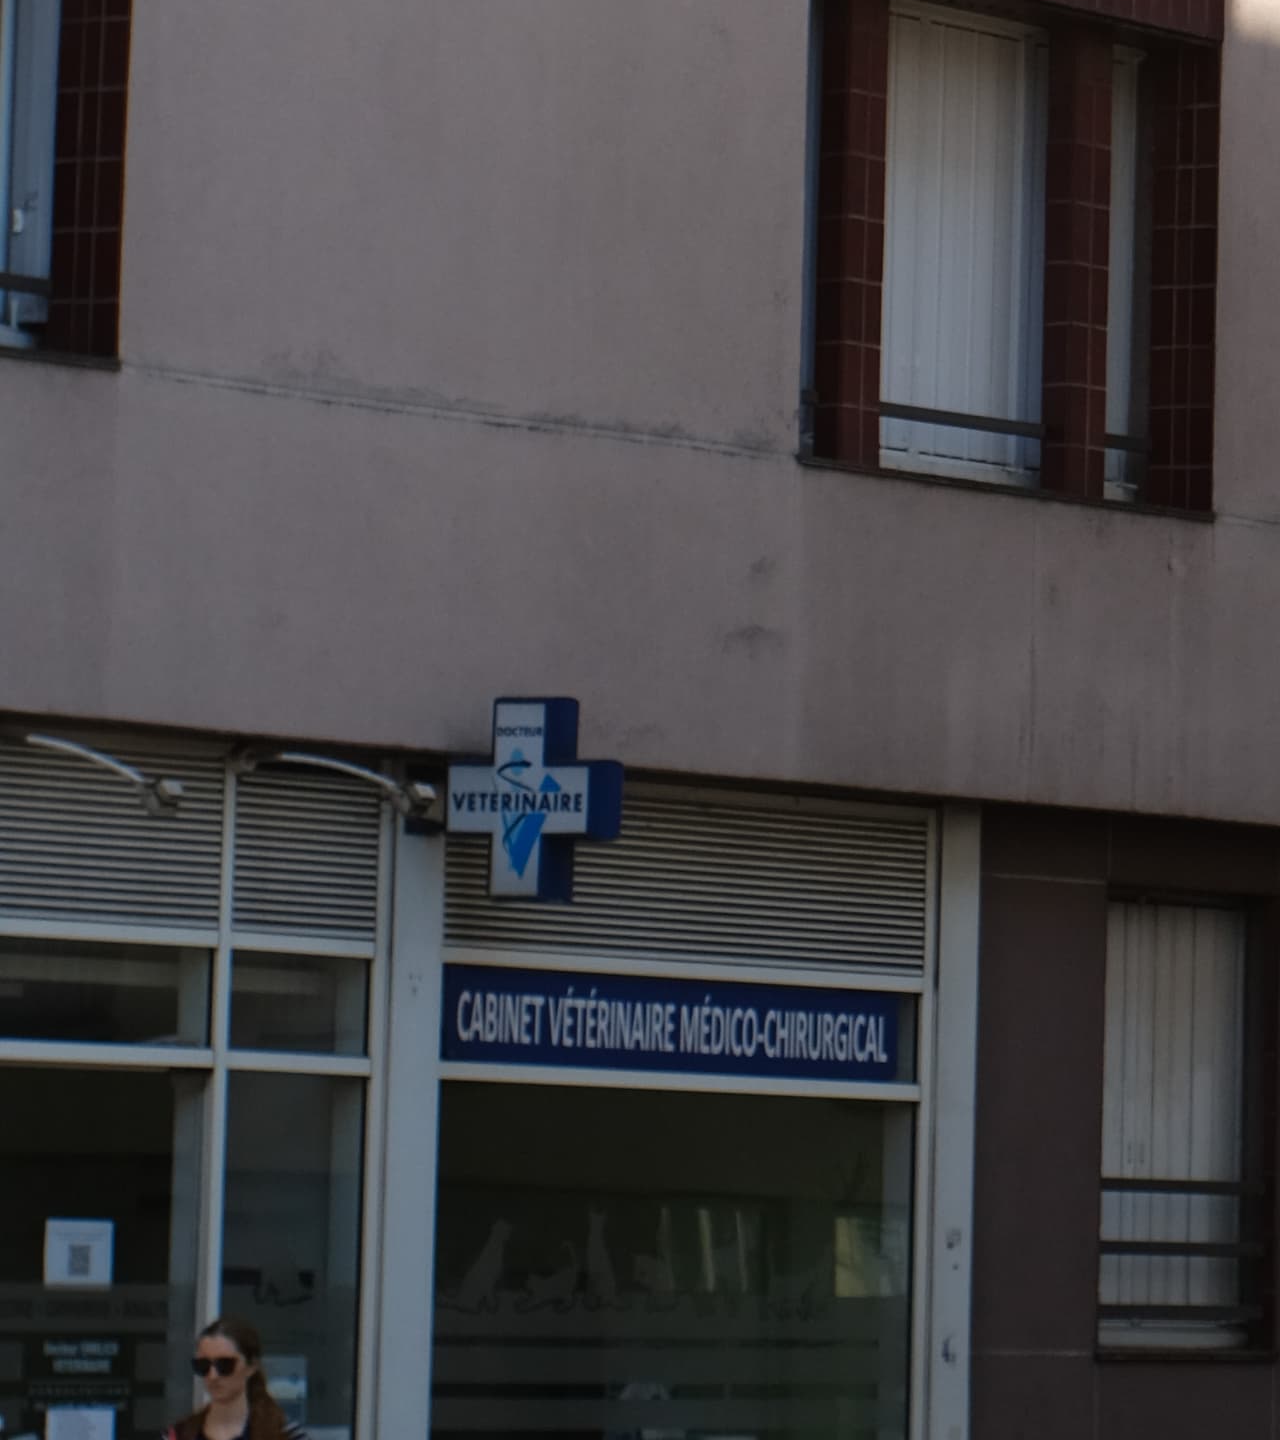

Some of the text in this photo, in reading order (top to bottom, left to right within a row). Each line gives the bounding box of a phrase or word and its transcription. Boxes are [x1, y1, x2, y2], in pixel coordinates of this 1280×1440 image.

[496, 726, 544, 738] DOCTEUR
[455, 985, 889, 1065] CABINET VÉTÉRINAIRE MÉDICO-CHIRURGICAL
